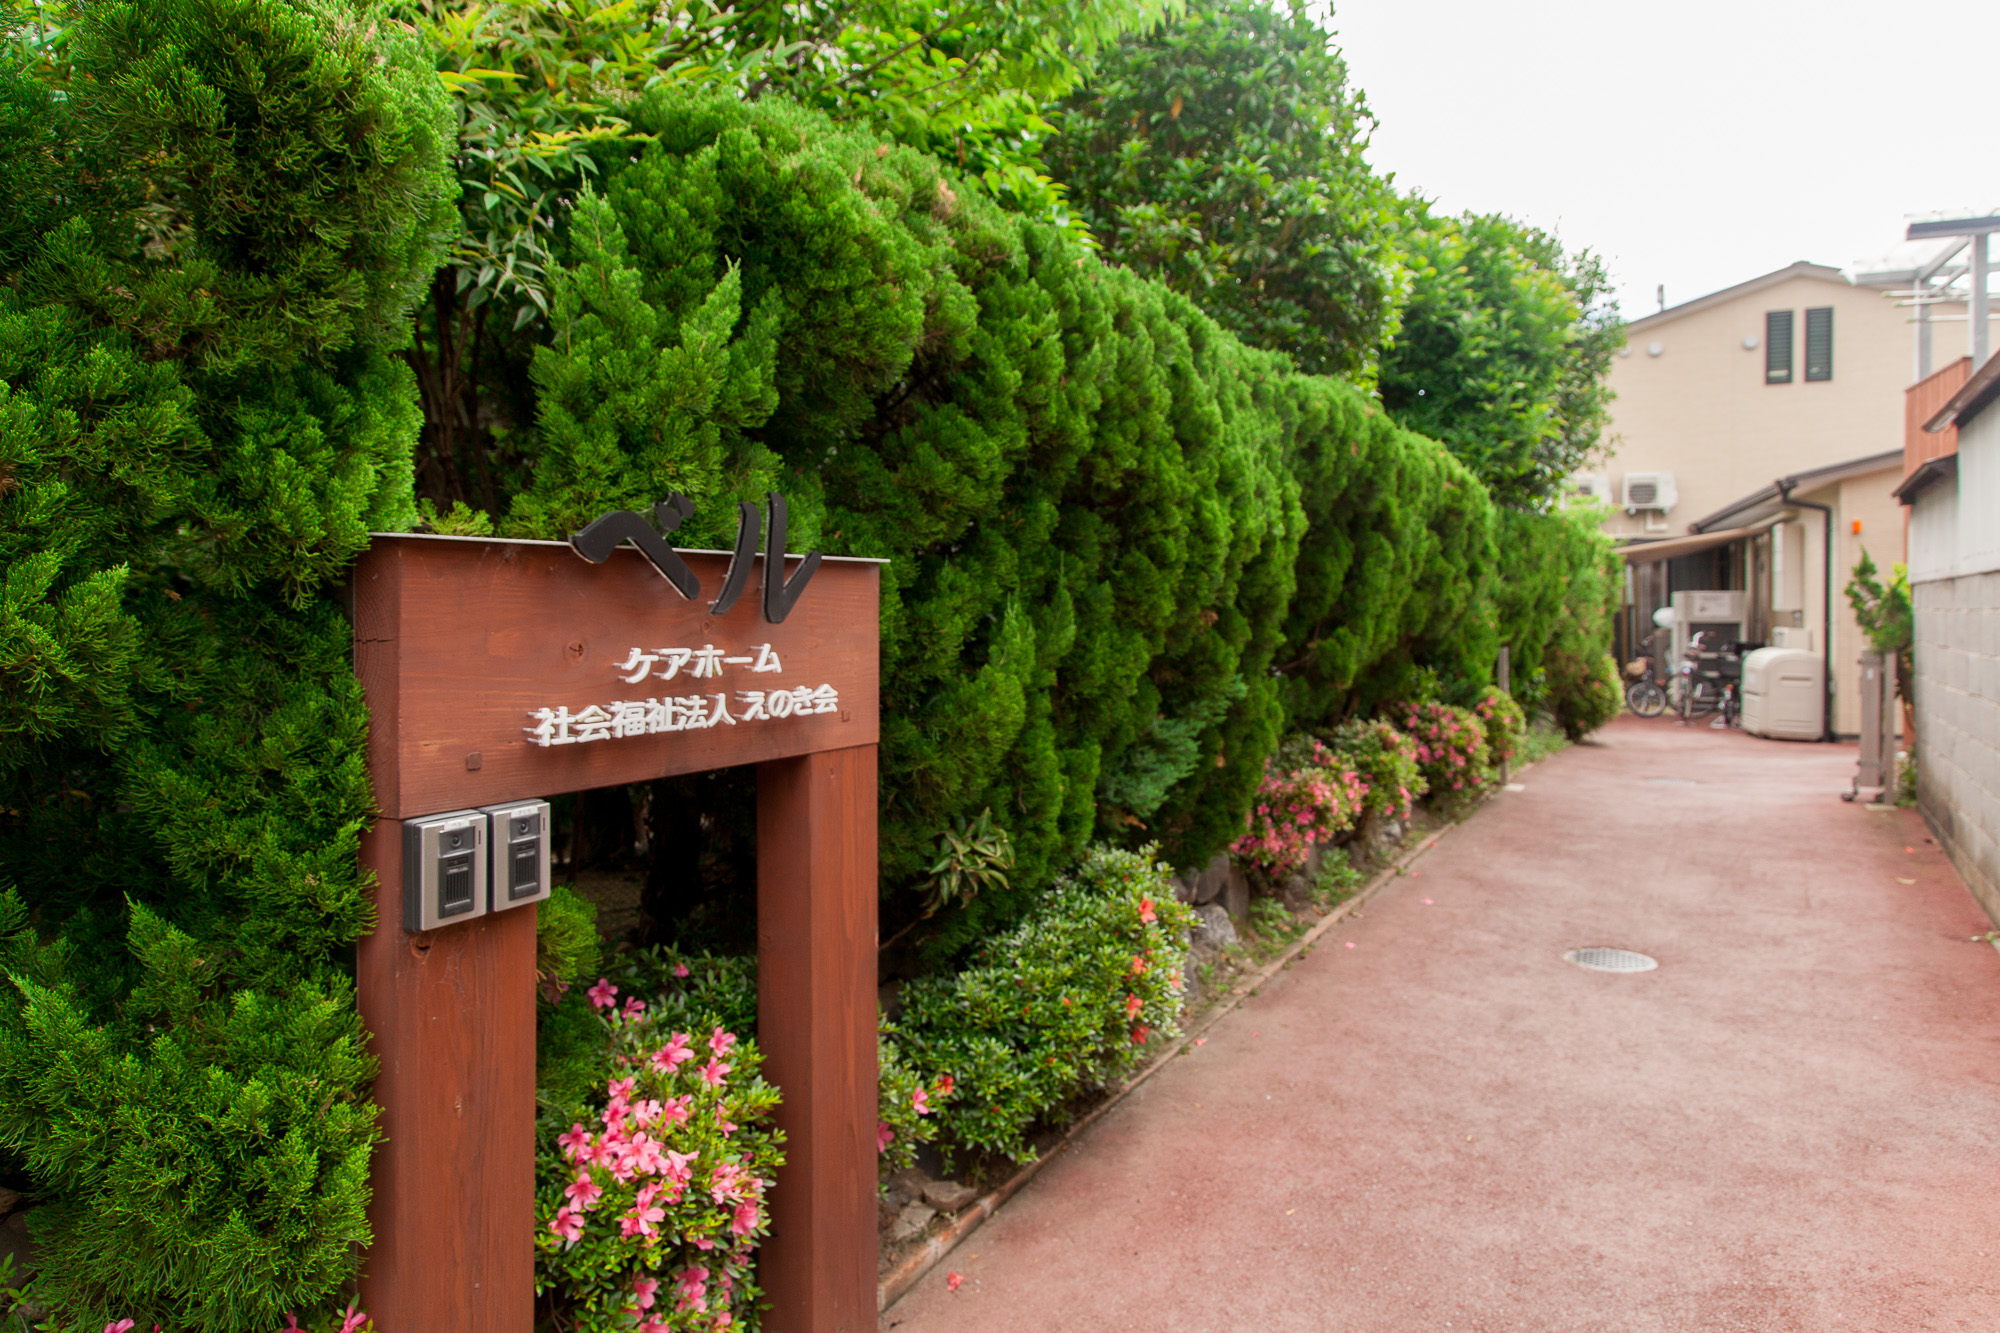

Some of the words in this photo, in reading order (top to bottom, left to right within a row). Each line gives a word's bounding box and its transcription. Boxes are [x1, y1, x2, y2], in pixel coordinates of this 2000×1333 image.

[568, 491, 822, 624] ベル
[619, 643, 782, 683] ケアホーム
[532, 692, 736, 747] 社会福祉法人
[742, 684, 839, 721] えのき会
